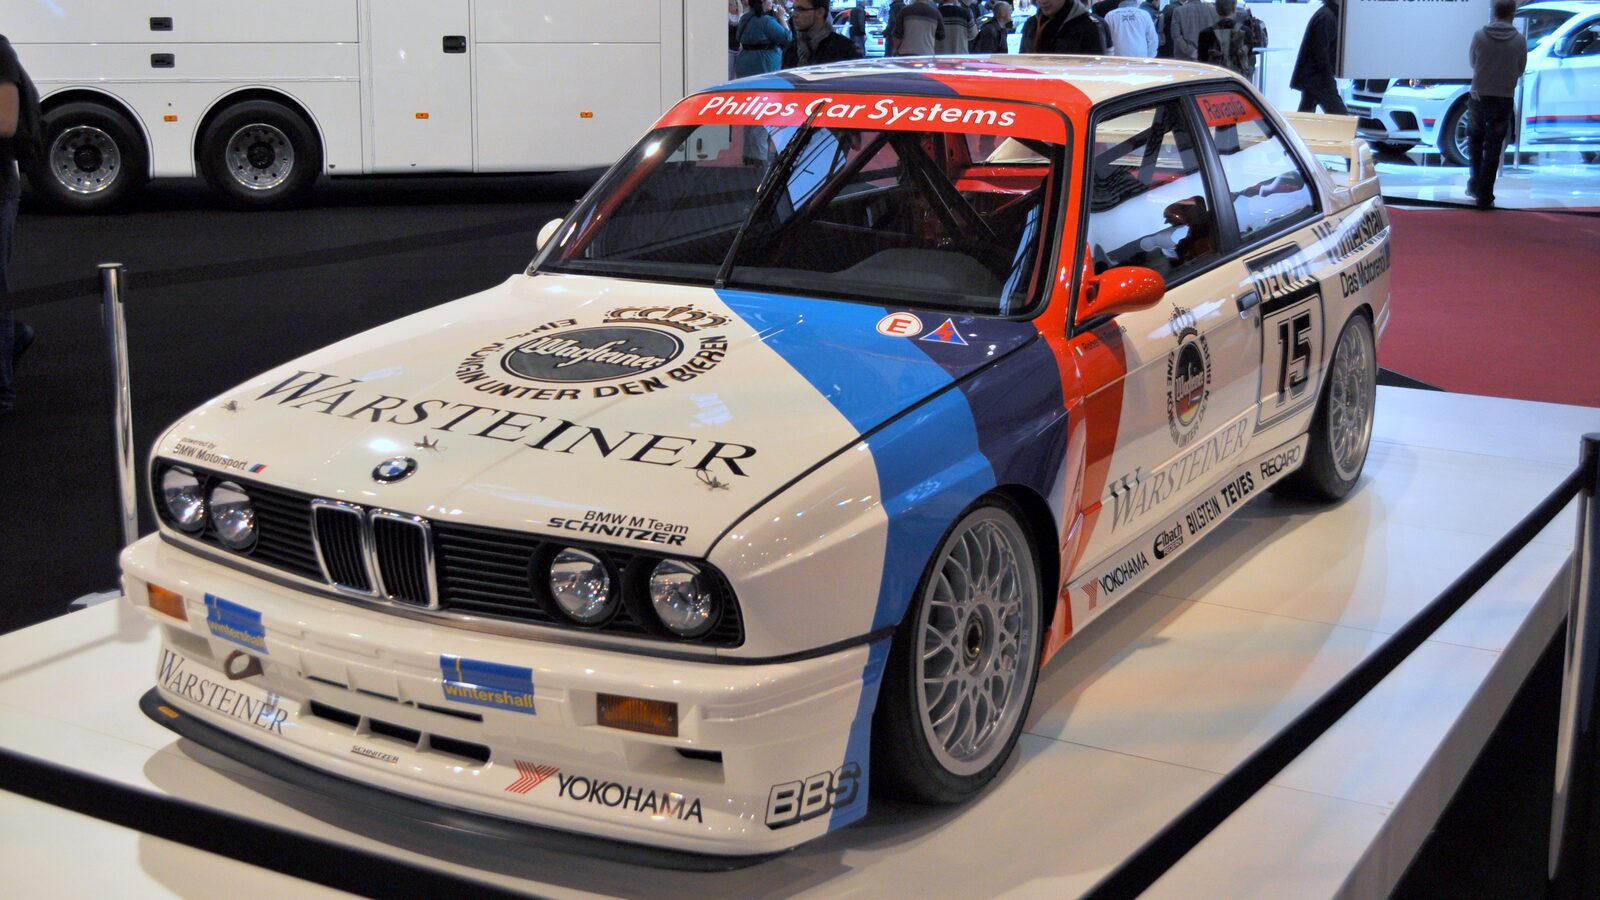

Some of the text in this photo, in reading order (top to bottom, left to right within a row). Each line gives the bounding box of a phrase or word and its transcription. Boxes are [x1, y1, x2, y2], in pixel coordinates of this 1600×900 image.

[698, 96, 1016, 126] Philips Car Systems
[1339, 271, 1360, 298] Das
[886, 318, 911, 334] E
[475, 379, 581, 400] UNTER
[593, 376, 669, 398] DEN
[666, 335, 728, 382] BIEREN
[1277, 309, 1313, 408] 15
[255, 370, 757, 477] WARSTEINER
[173, 444, 248, 470] BMW Motorsport
[1108, 416, 1248, 534] WARSTEINER
[1260, 445, 1300, 480] RECARO
[1220, 471, 1255, 508] TEVES
[547, 517, 686, 546] SCHNITZER
[584, 510, 689, 534] BMW M Team
[1186, 496, 1221, 535] BILSTEIN
[1099, 552, 1149, 595] YOKOHAMA
[158, 649, 288, 735] WARSTEINER
[446, 684, 534, 708] wintershall
[558, 772, 704, 823] YOKOHAMA
[765, 761, 862, 830] BBS
